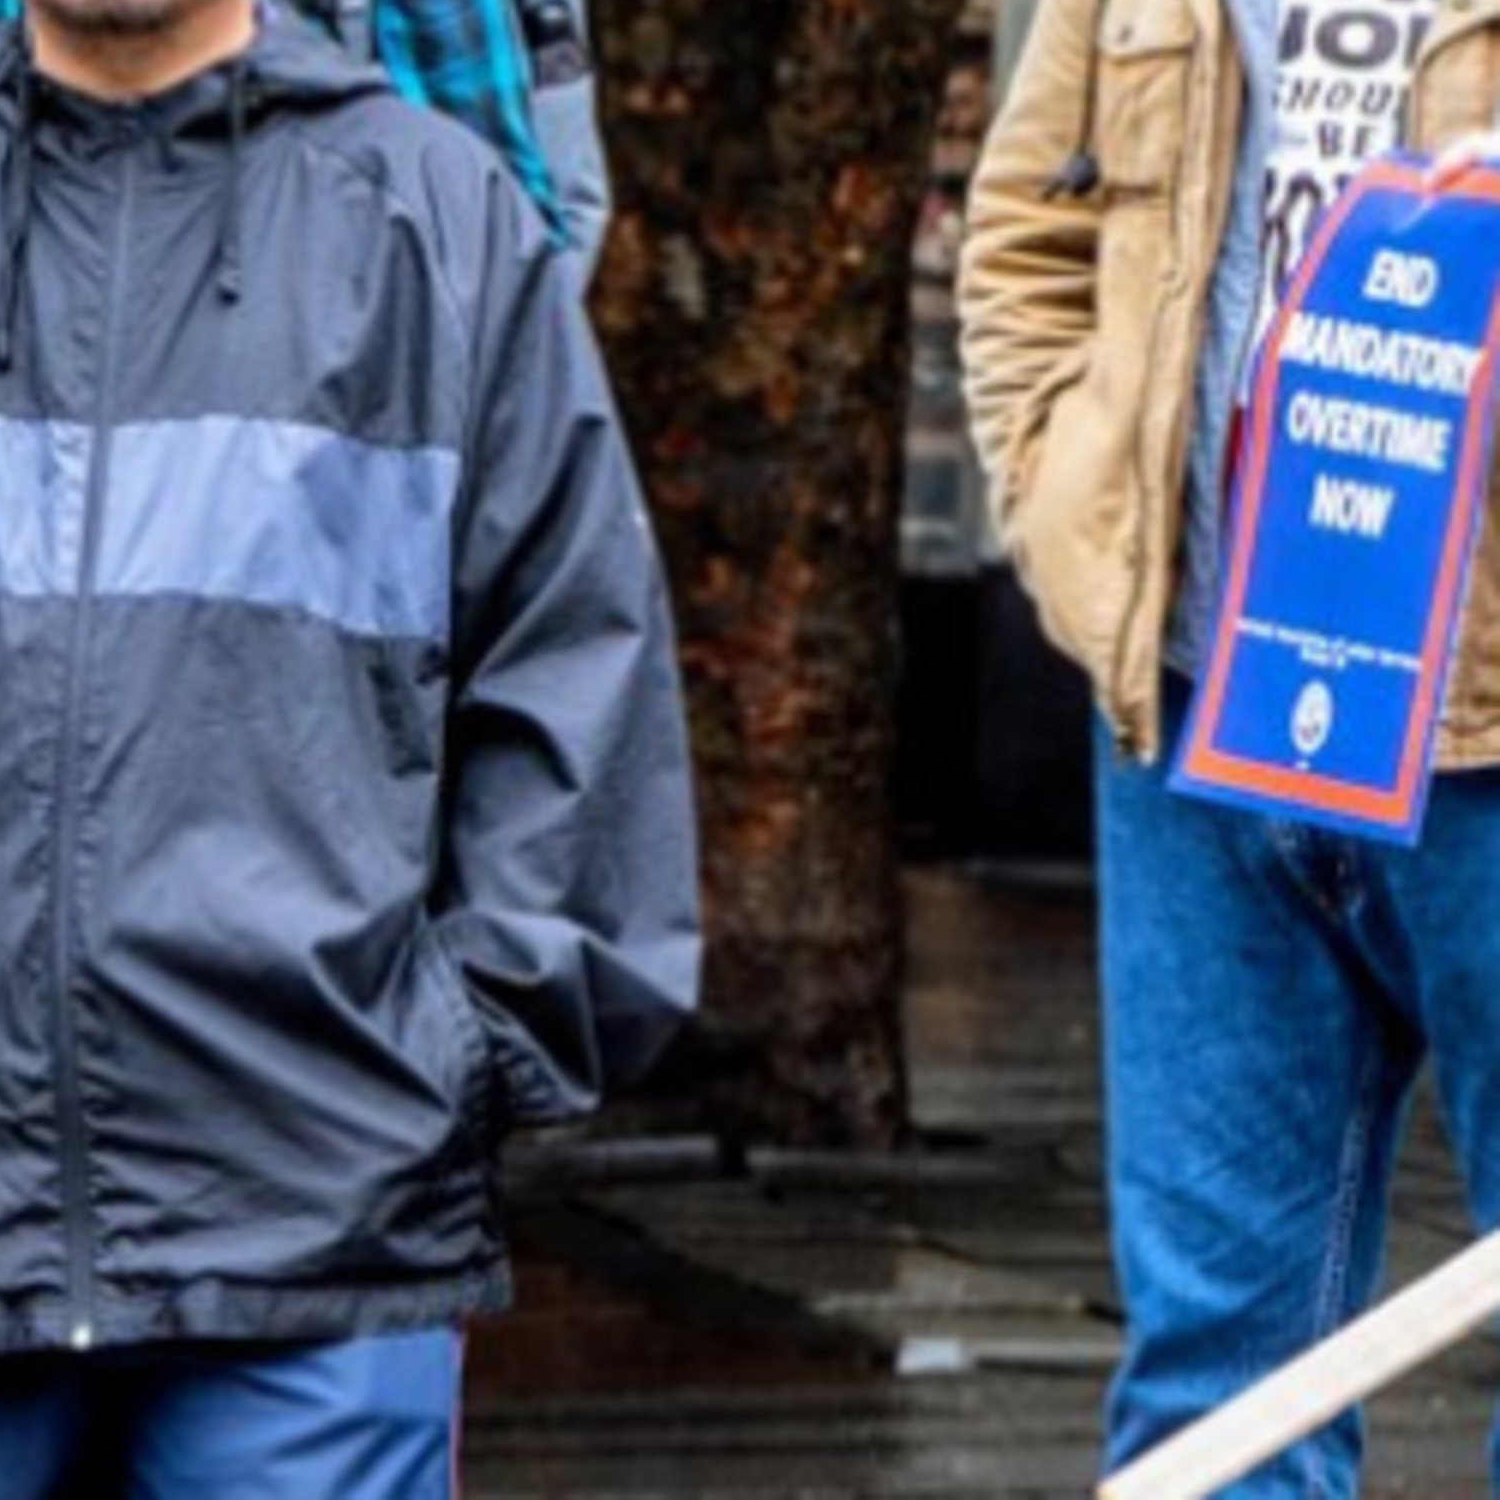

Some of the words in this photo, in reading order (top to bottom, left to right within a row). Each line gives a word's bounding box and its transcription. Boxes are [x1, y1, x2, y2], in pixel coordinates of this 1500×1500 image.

[1362, 248, 1440, 309] END
[1279, 309, 1488, 397] MANDATORY
[1286, 389, 1452, 474] OVERTIME
[1309, 472, 1396, 540] NOW
